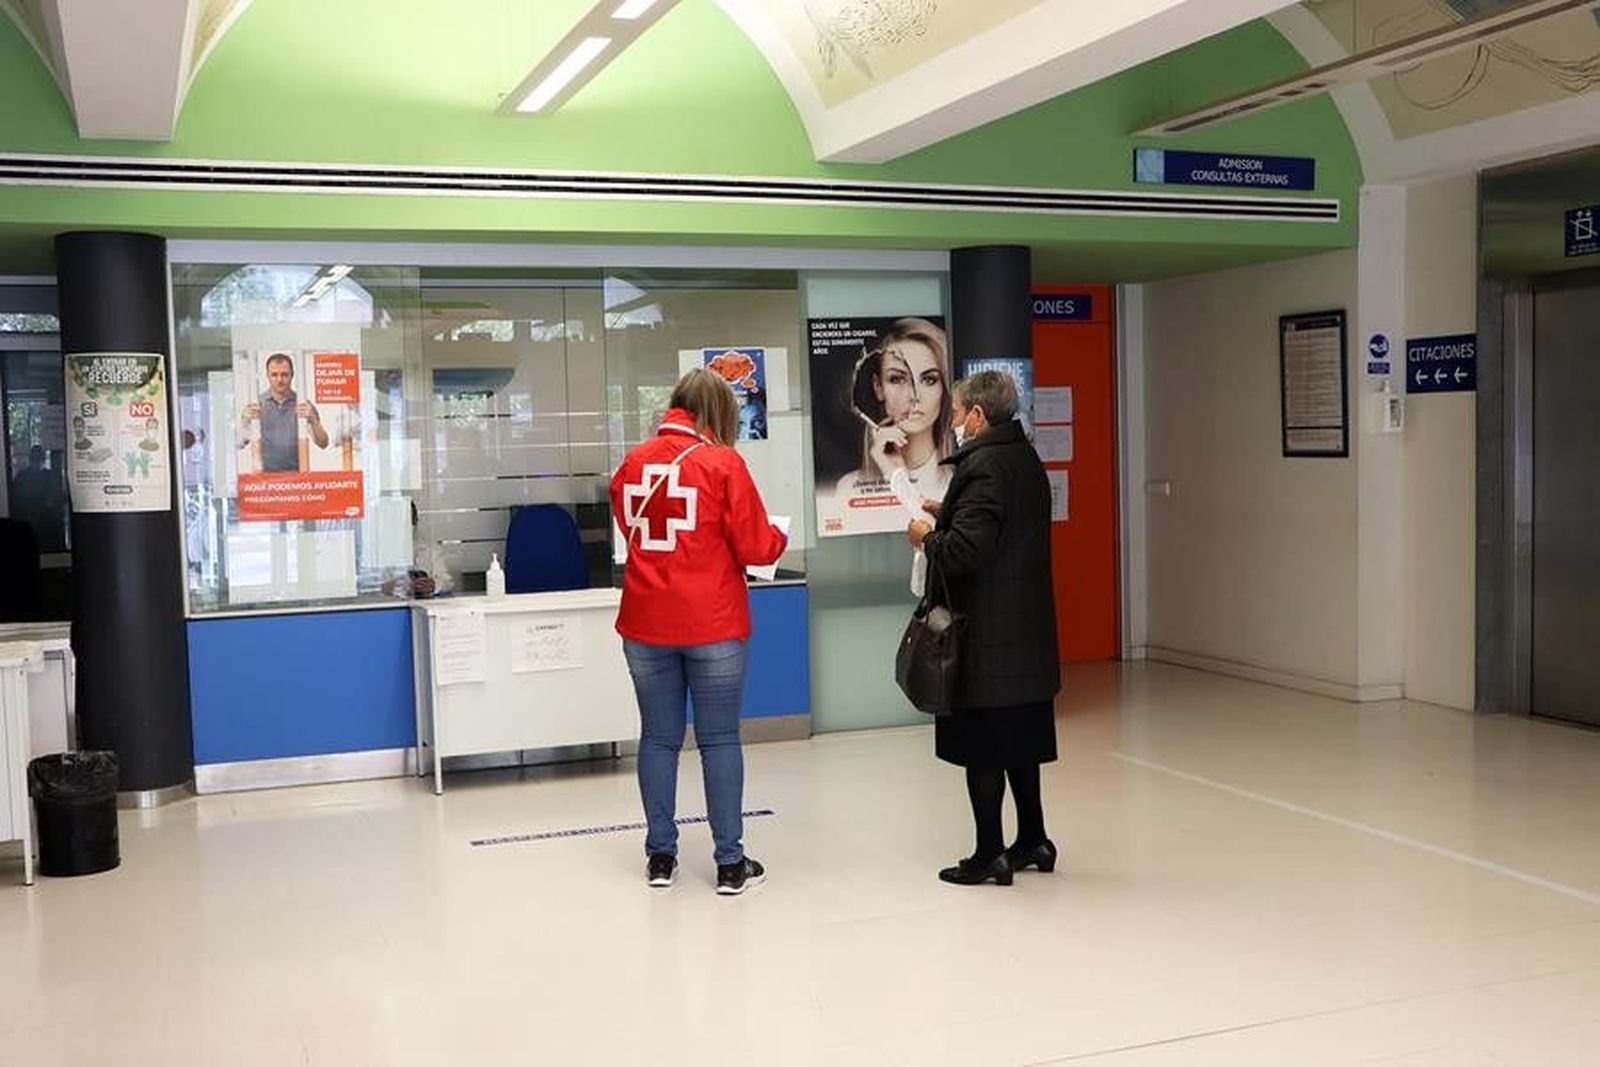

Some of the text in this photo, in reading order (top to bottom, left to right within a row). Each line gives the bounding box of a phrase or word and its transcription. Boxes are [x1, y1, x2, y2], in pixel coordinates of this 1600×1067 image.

[1191, 170, 1289, 186] CONSULTAS EXTERNAS
[811, 322, 827, 330] CADA
[1408, 342, 1474, 362] CITACIONES
[88, 371, 143, 384] RECUERDE
[130, 403, 153, 416] NO
[269, 481, 313, 491] PODEMOS
[314, 480, 358, 490] AYUDARTE
